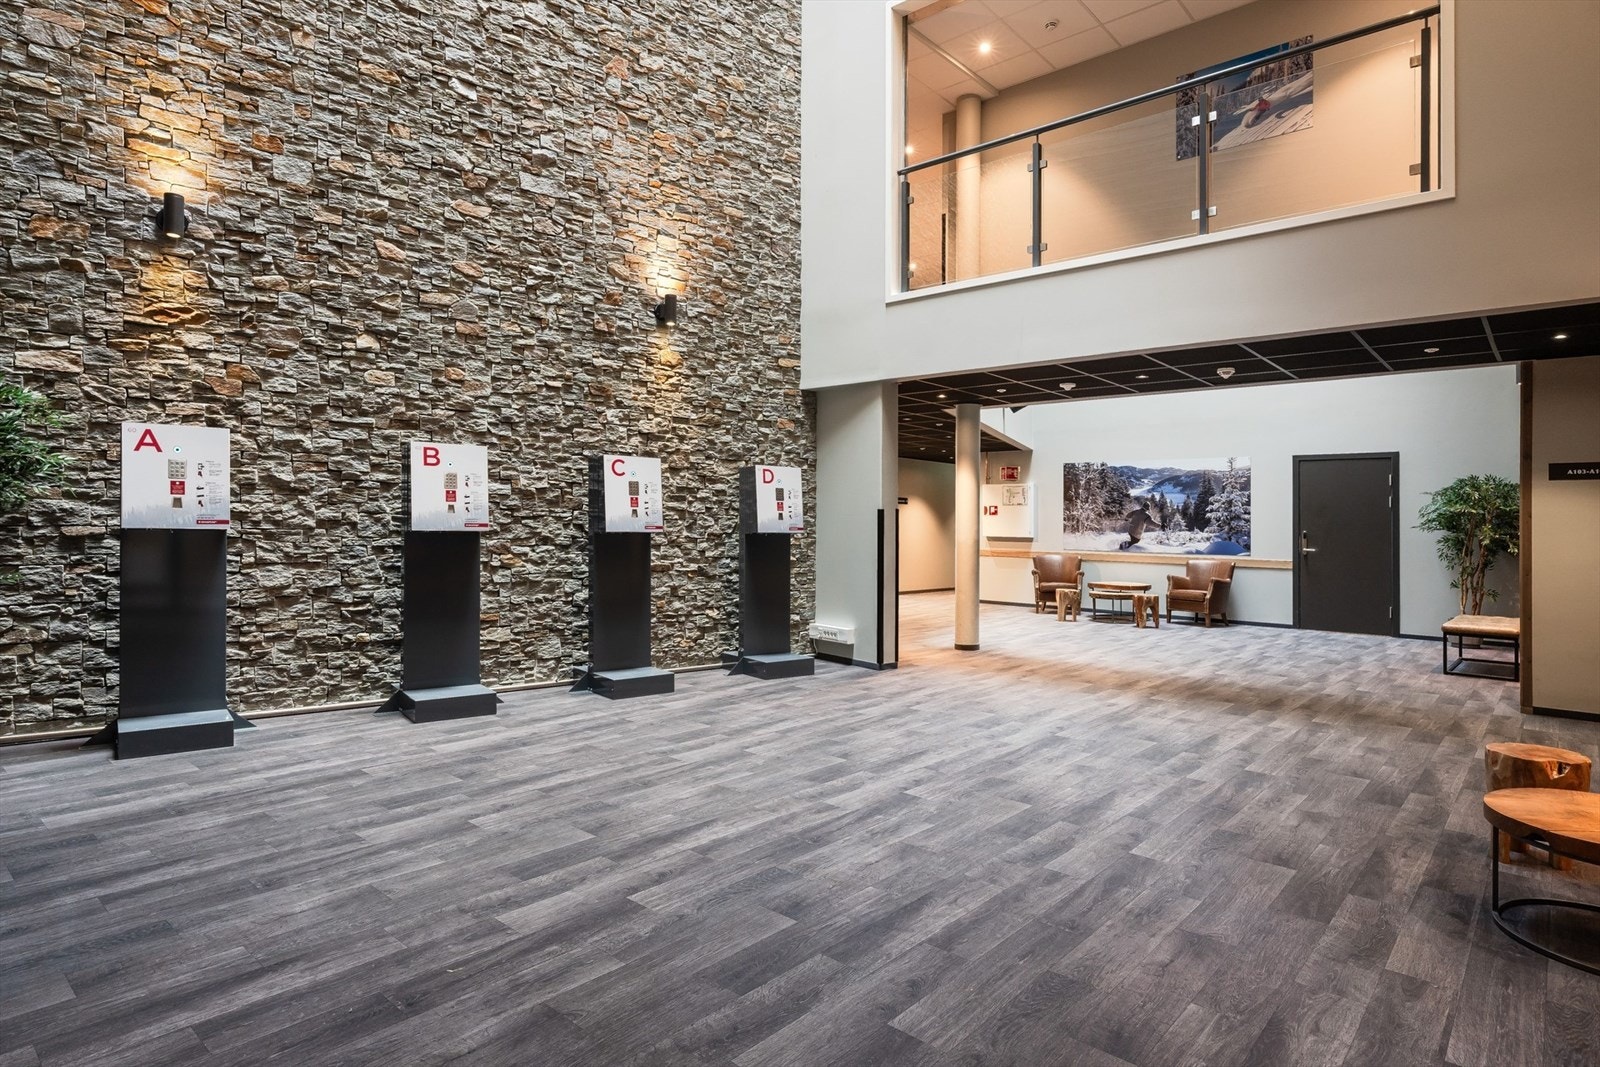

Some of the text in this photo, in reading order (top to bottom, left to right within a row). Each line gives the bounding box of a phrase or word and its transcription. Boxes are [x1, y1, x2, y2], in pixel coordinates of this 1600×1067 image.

[133, 428, 163, 452] A
[423, 446, 441, 466] B
[611, 459, 625, 476] C
[762, 468, 774, 484] D
